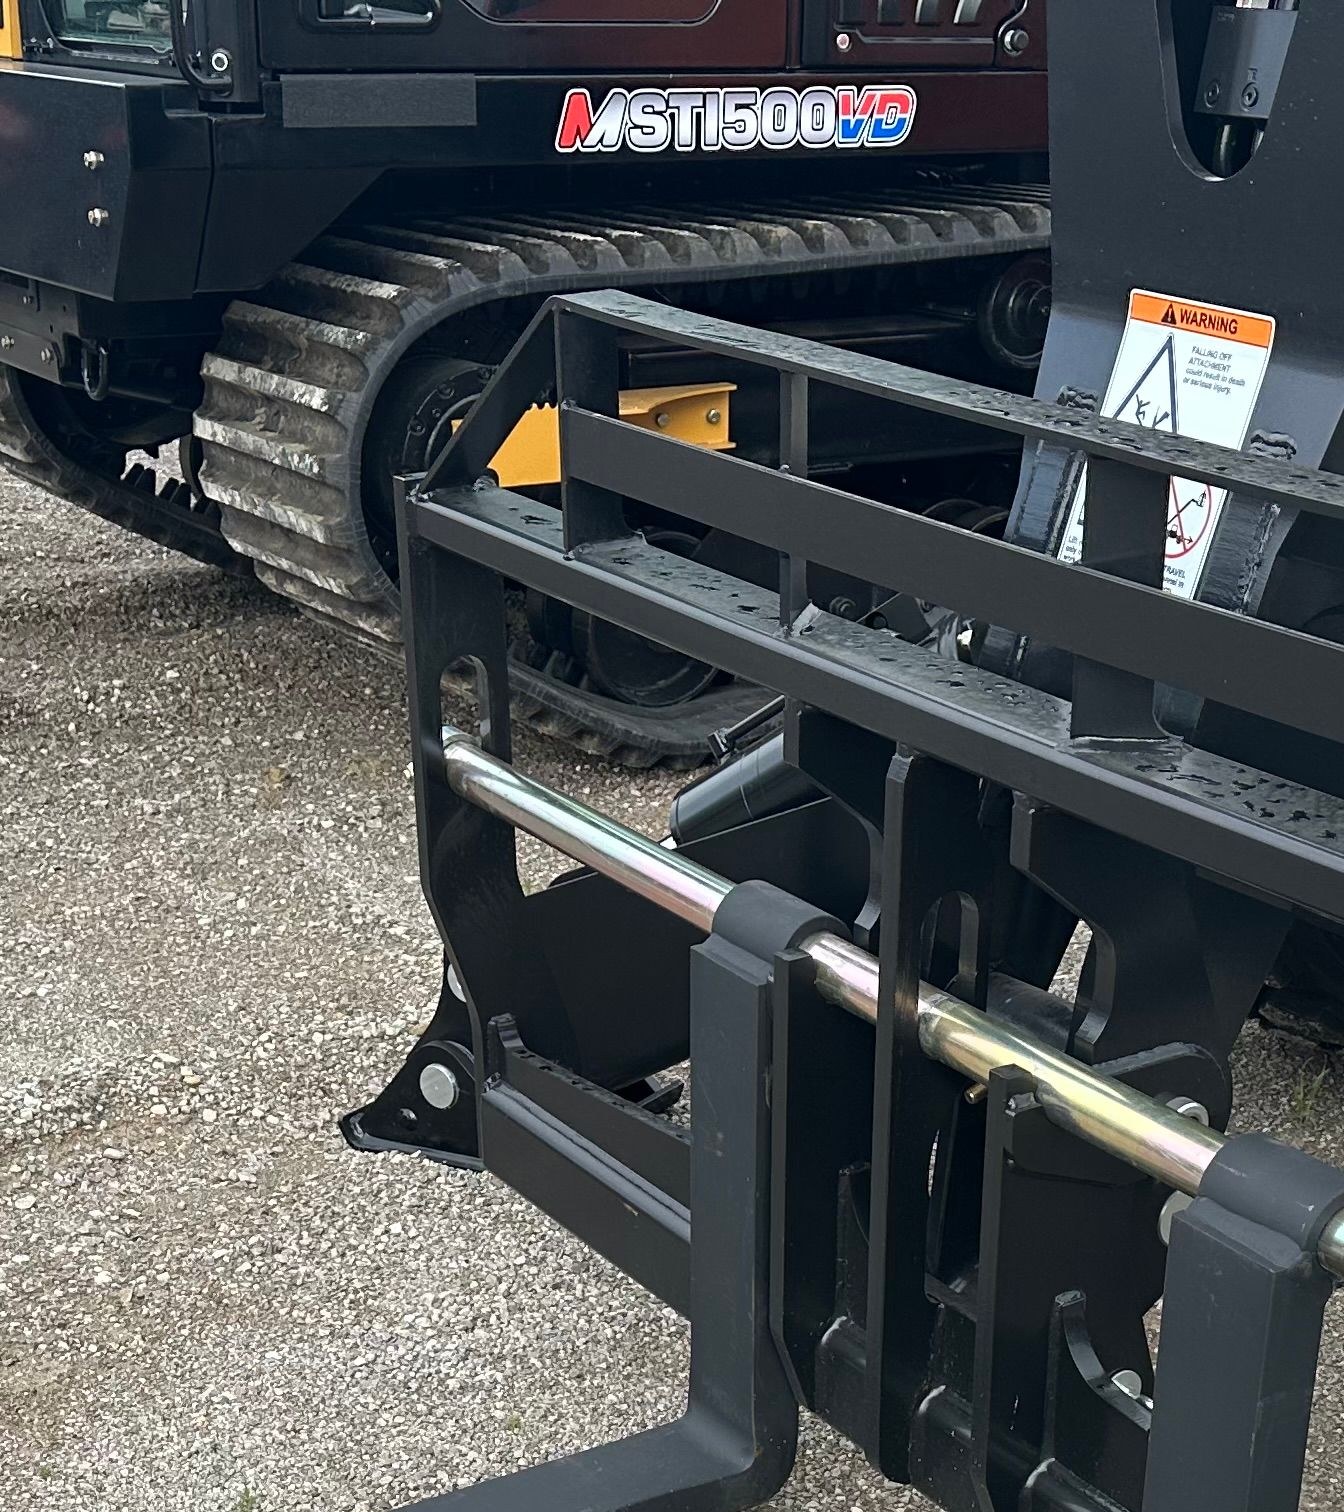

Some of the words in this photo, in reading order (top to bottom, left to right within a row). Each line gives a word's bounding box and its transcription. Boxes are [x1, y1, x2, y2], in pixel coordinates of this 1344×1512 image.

[556, 85, 917, 153] MST1500VD
[1180, 308, 1238, 334] WARNING
[1192, 345, 1218, 359] FALLING
